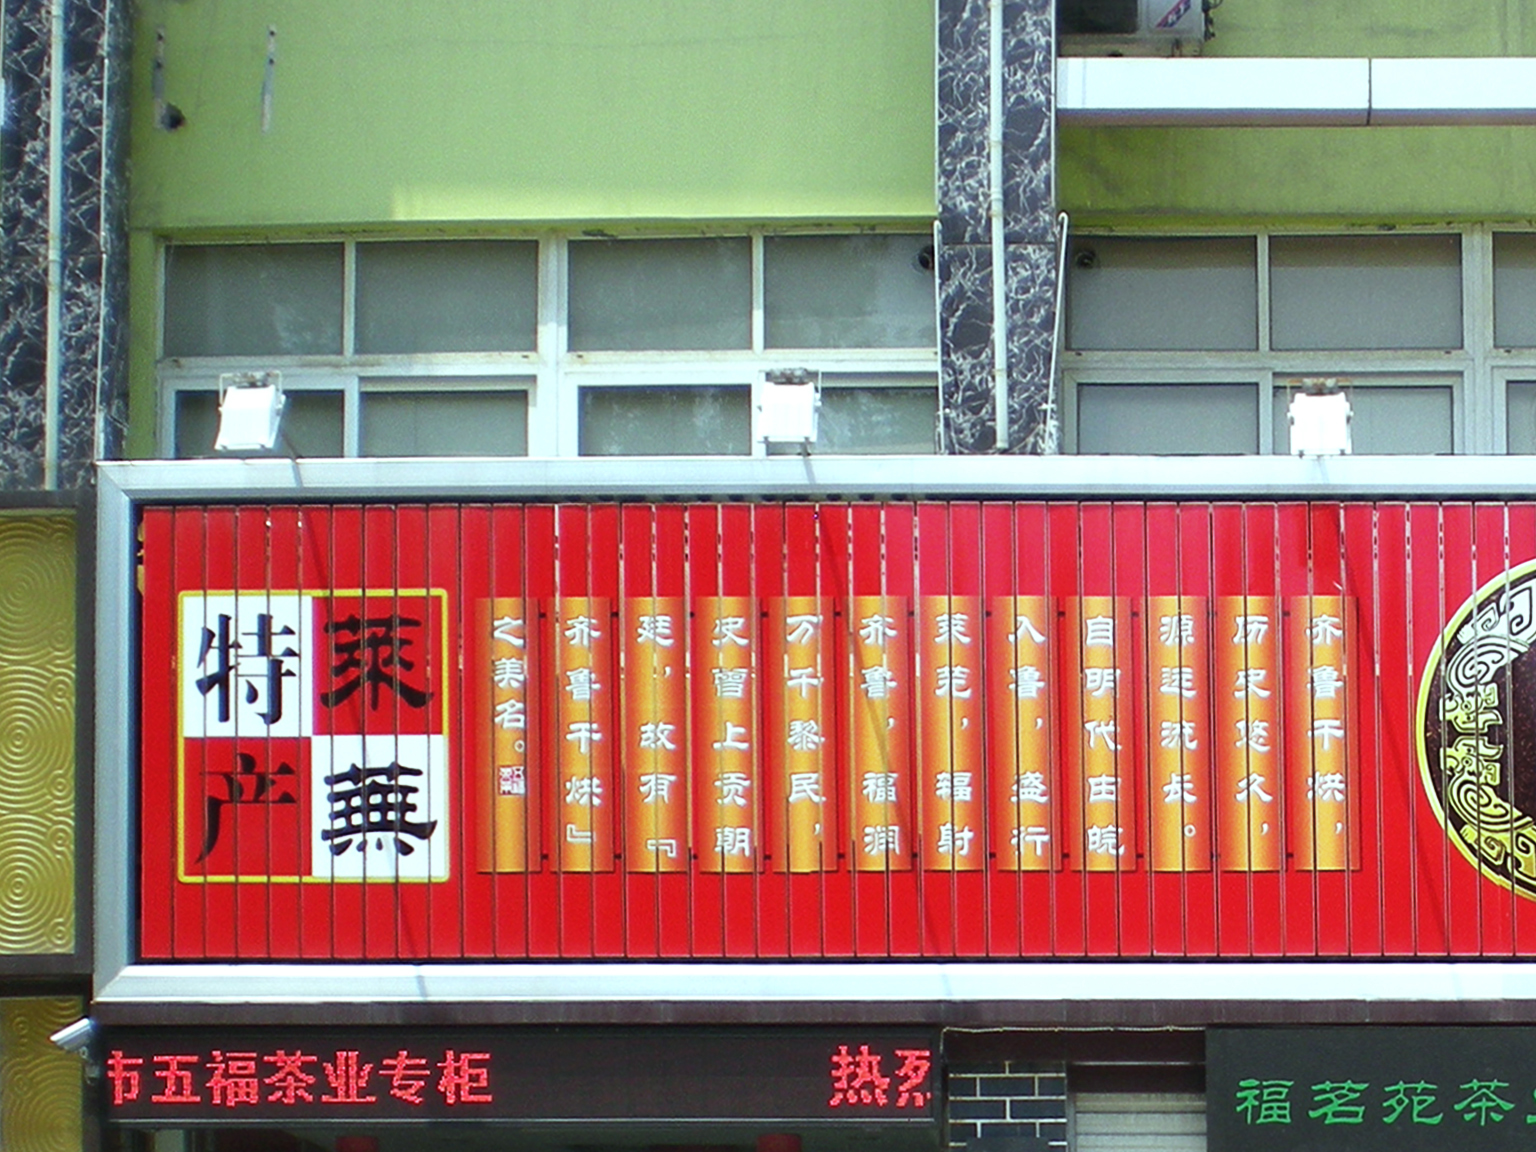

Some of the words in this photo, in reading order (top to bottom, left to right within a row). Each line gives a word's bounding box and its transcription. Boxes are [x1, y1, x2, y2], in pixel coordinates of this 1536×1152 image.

[492, 615, 526, 754] 之美名。
[711, 616, 751, 857] 史曾上贡朝
[785, 614, 826, 836] 万千黎民，
[859, 614, 899, 856] 齐鲁，福润
[933, 613, 974, 856] 莱芜，辐射
[1007, 614, 1050, 857] 入鲁，盛行
[1083, 615, 1125, 857] 自明代由皖
[1159, 614, 1198, 838] 源远流长。
[1232, 614, 1273, 836] 历史悠久，
[1305, 614, 1345, 835] 齐鲁干烘，
[106, 1049, 494, 1106] 市五福茶业专柜
